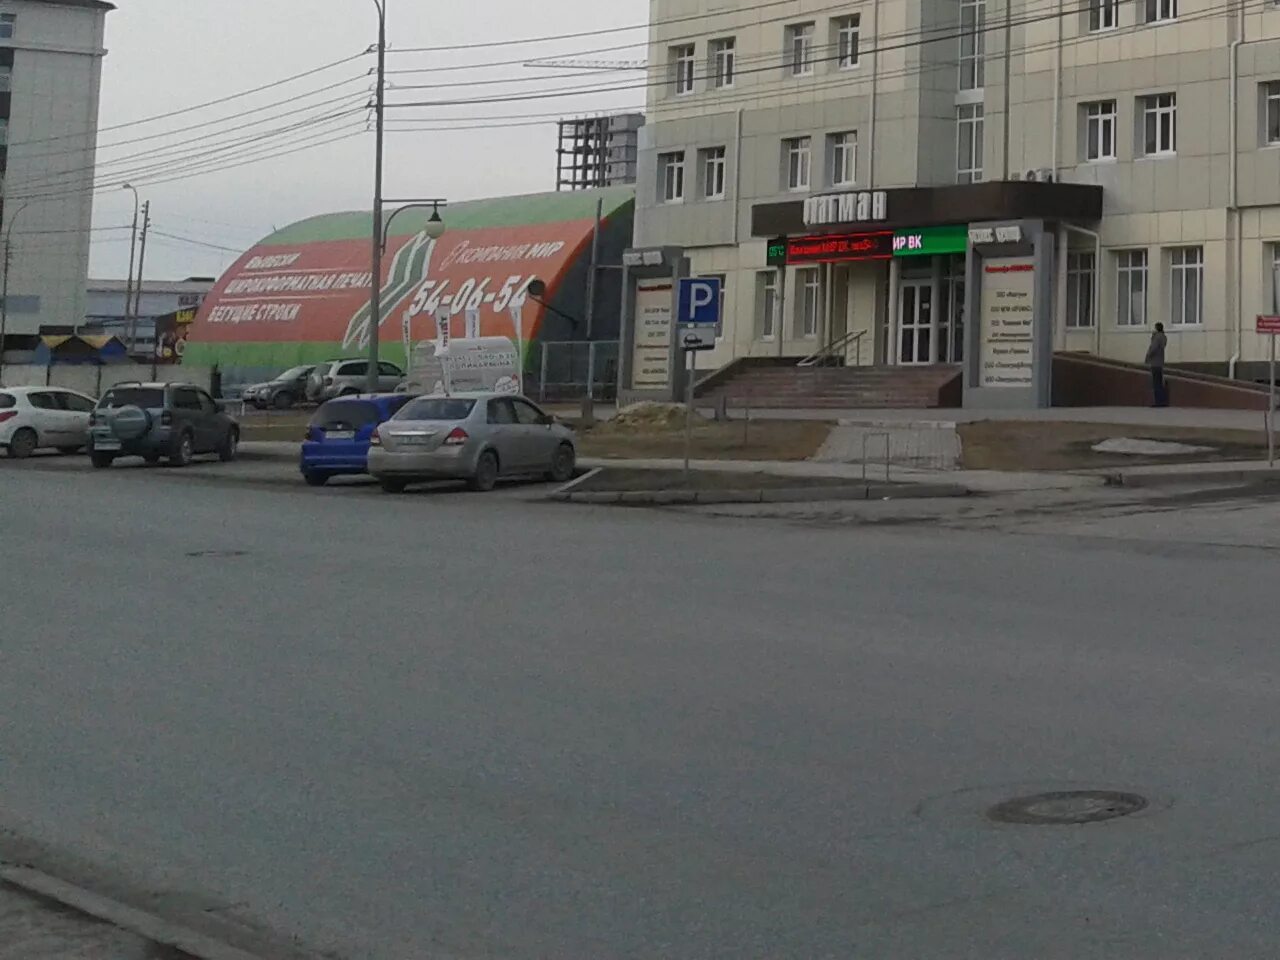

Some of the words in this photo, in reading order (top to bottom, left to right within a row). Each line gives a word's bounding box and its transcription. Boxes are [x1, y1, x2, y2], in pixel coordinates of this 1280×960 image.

[524, 241, 565, 259] МИР
[409, 274, 537, 316] 54-06-54
[690, 283, 713, 319] P
[207, 305, 258, 324] БЕГУЩИЕ
[255, 303, 301, 321] СТРОКИ
